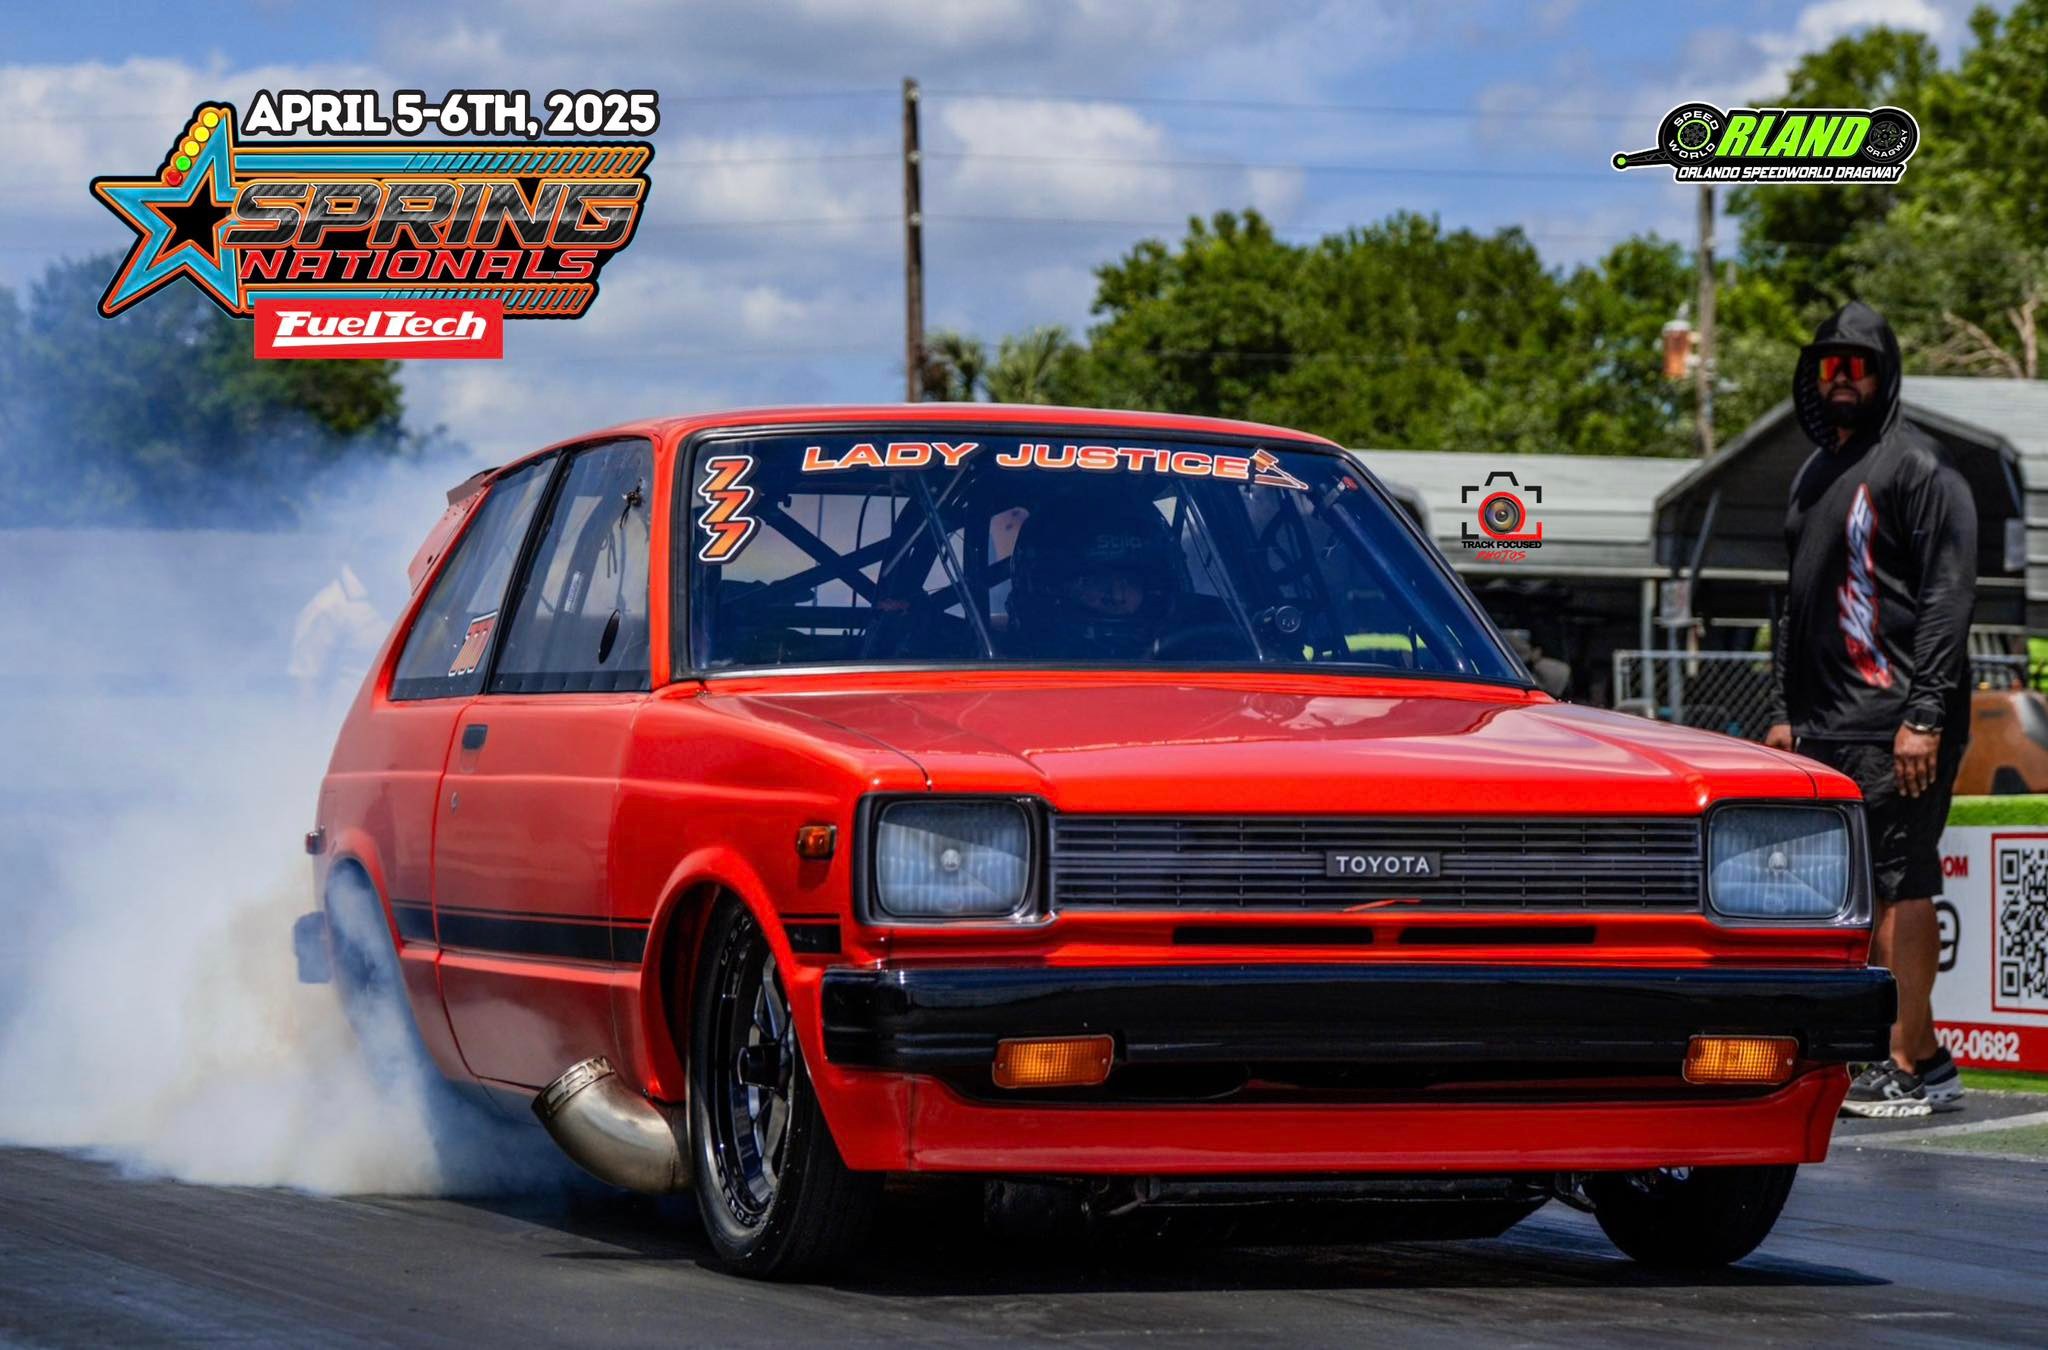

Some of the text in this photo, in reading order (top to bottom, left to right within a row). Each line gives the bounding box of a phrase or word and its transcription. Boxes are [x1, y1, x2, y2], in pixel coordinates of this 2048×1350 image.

[801, 441, 1251, 480] LADY JUSTICE
[1335, 855, 1431, 874] TOYOTA
[1934, 1027, 2020, 1062] 02-0682
